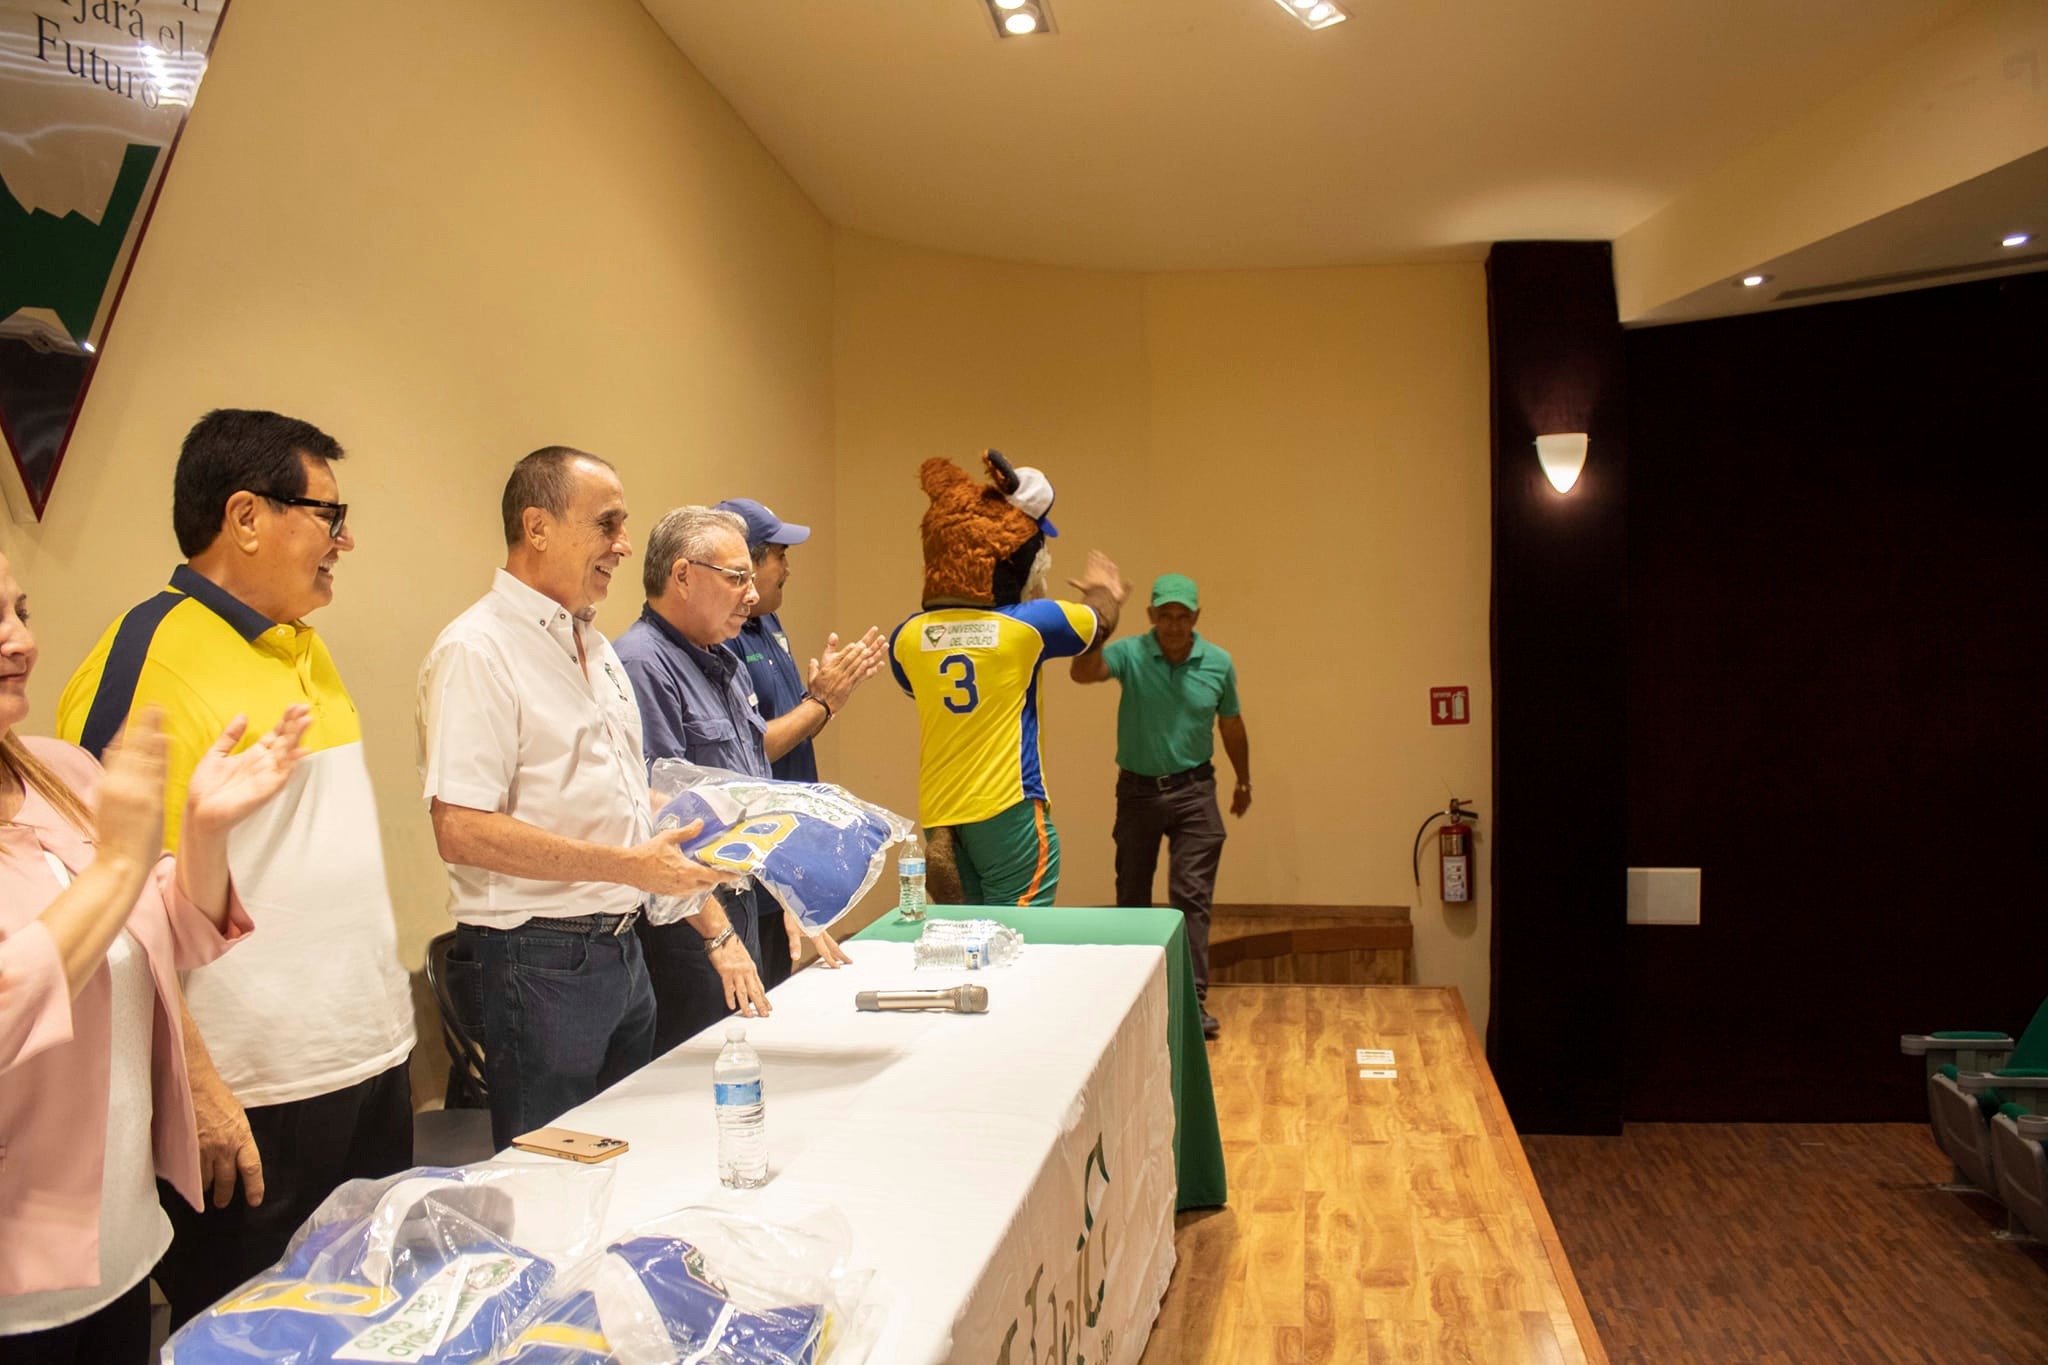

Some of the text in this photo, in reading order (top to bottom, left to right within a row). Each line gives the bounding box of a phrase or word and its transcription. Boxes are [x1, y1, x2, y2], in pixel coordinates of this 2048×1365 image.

[60, 0, 184, 59] jará el
[34, 13, 161, 109] Futuro
[950, 637, 963, 646] DEL
[939, 653, 980, 714] 3
